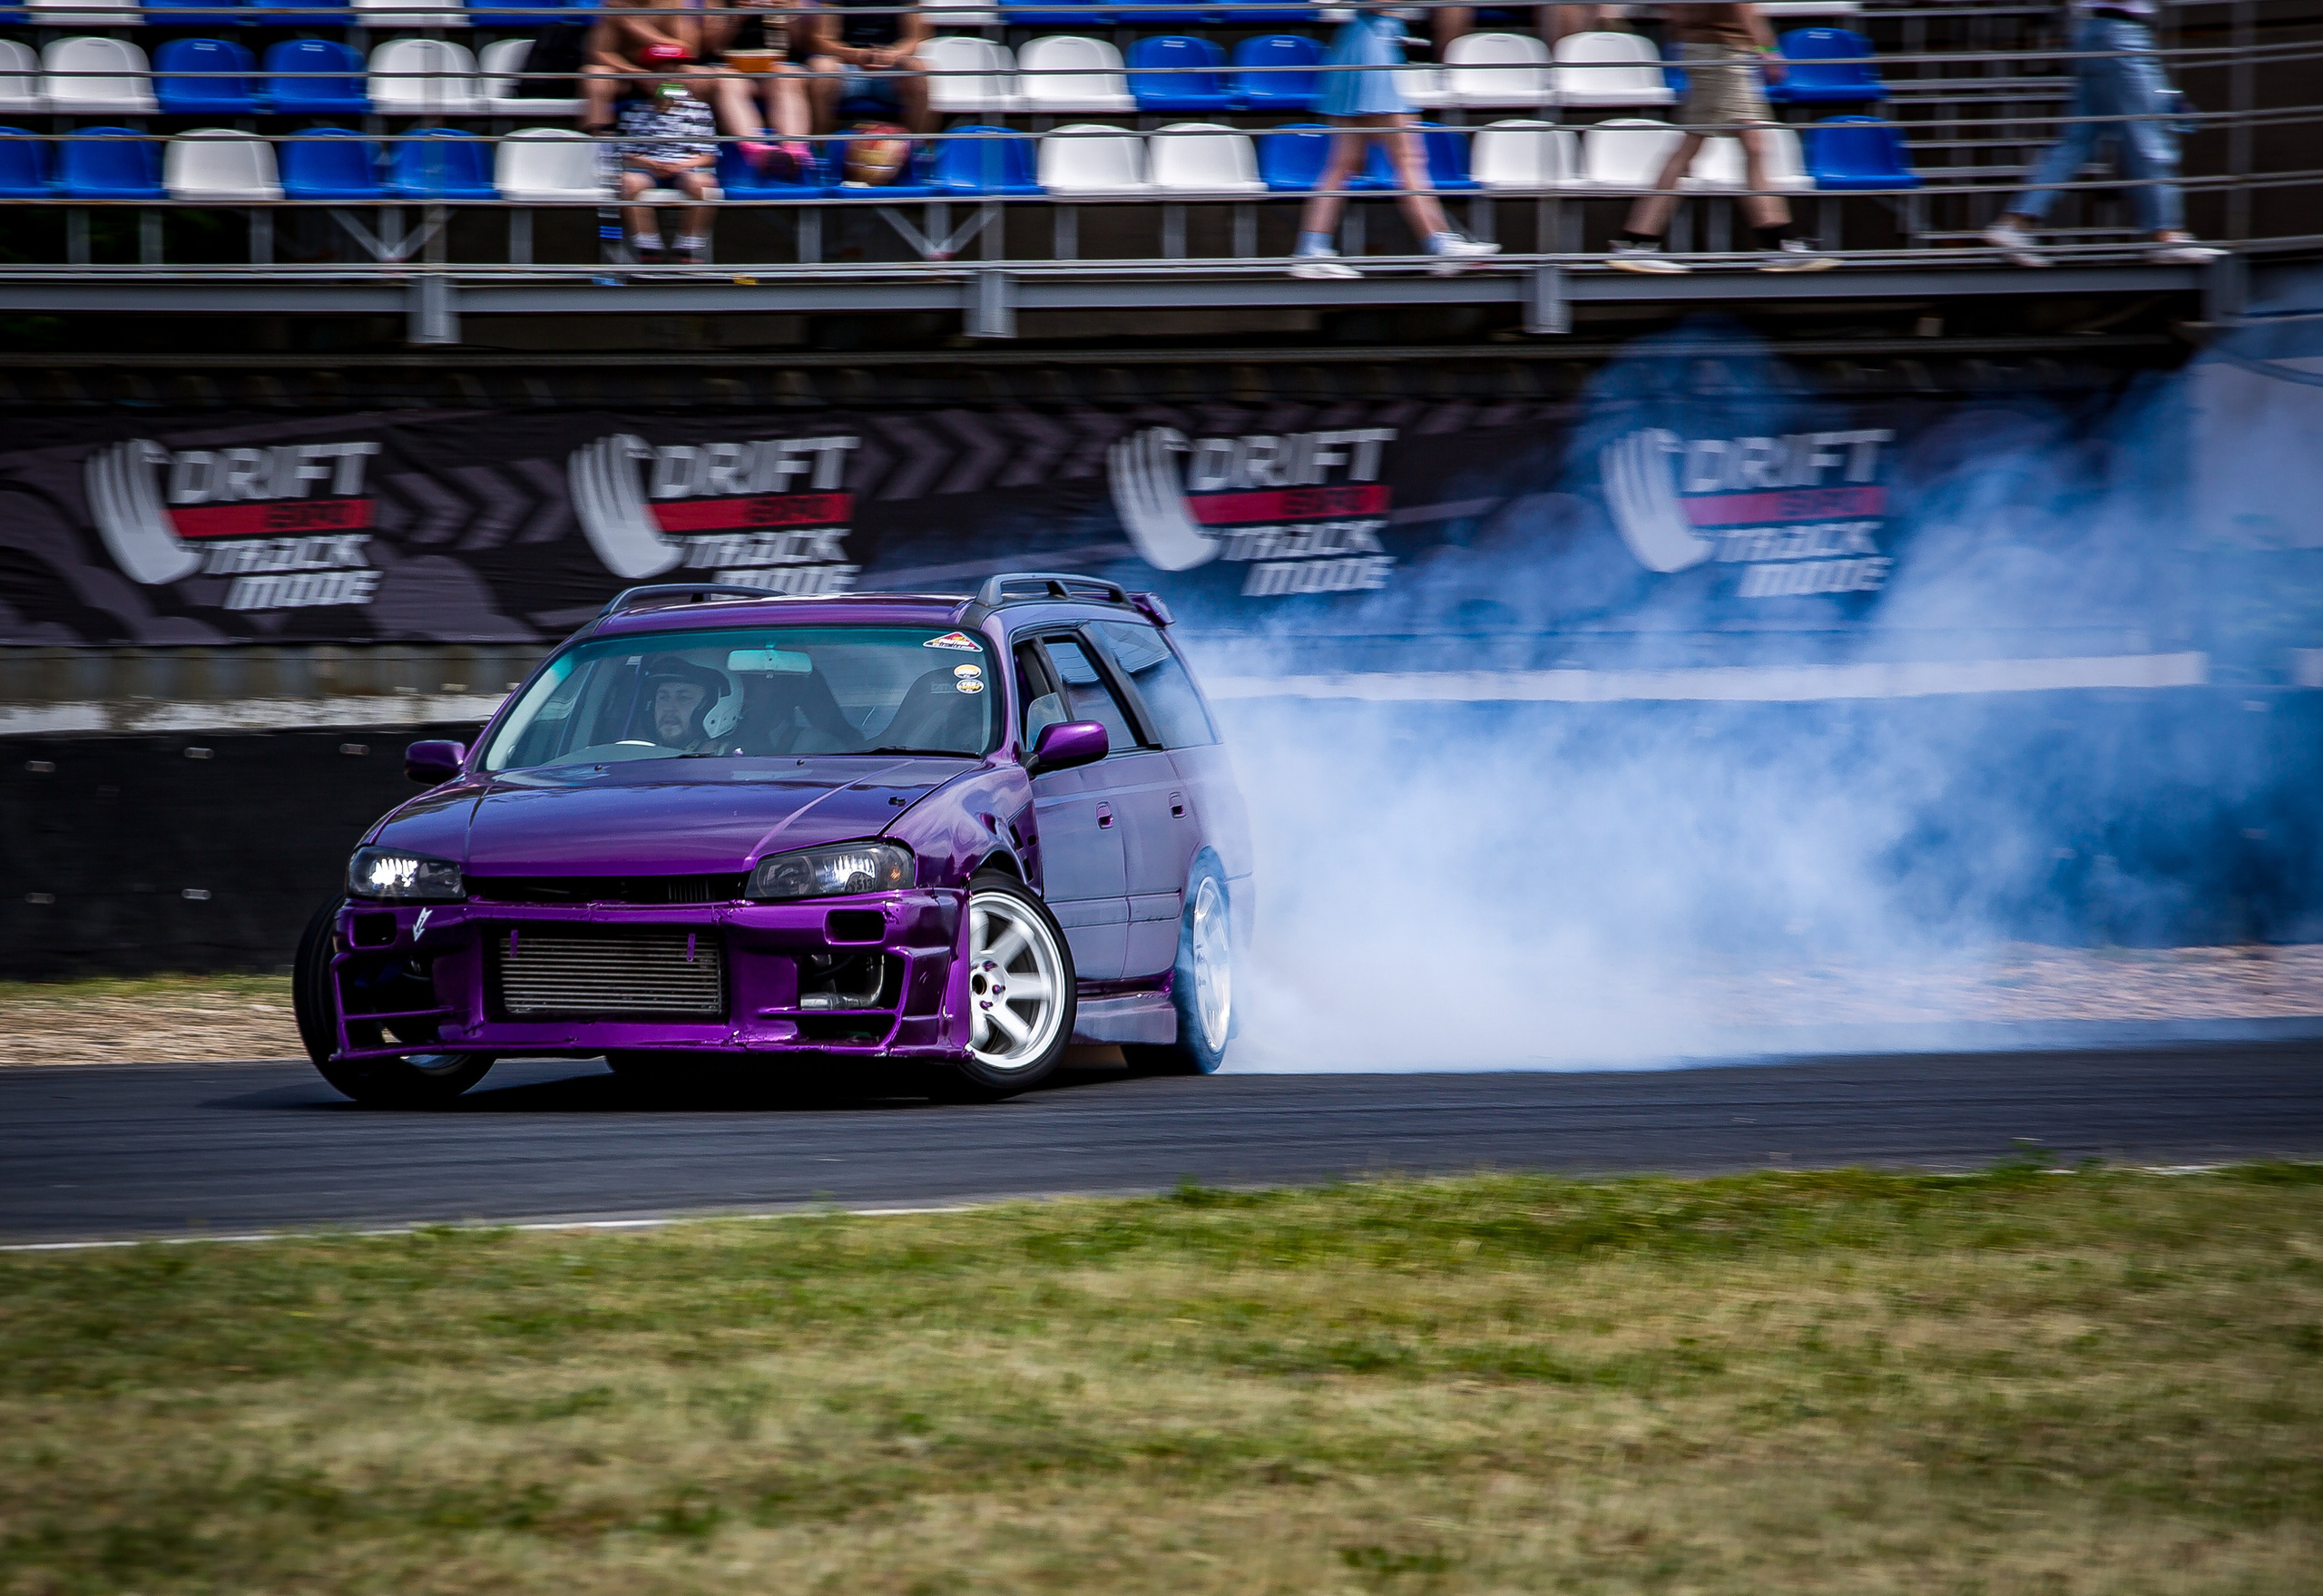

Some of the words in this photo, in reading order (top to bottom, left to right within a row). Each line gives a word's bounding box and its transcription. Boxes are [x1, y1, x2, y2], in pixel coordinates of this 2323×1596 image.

[168, 442, 383, 503] DRIFT
[649, 436, 862, 498] DRIFT
[1186, 428, 1398, 491] DRIFT
[1681, 429, 1897, 492] DRIFT
